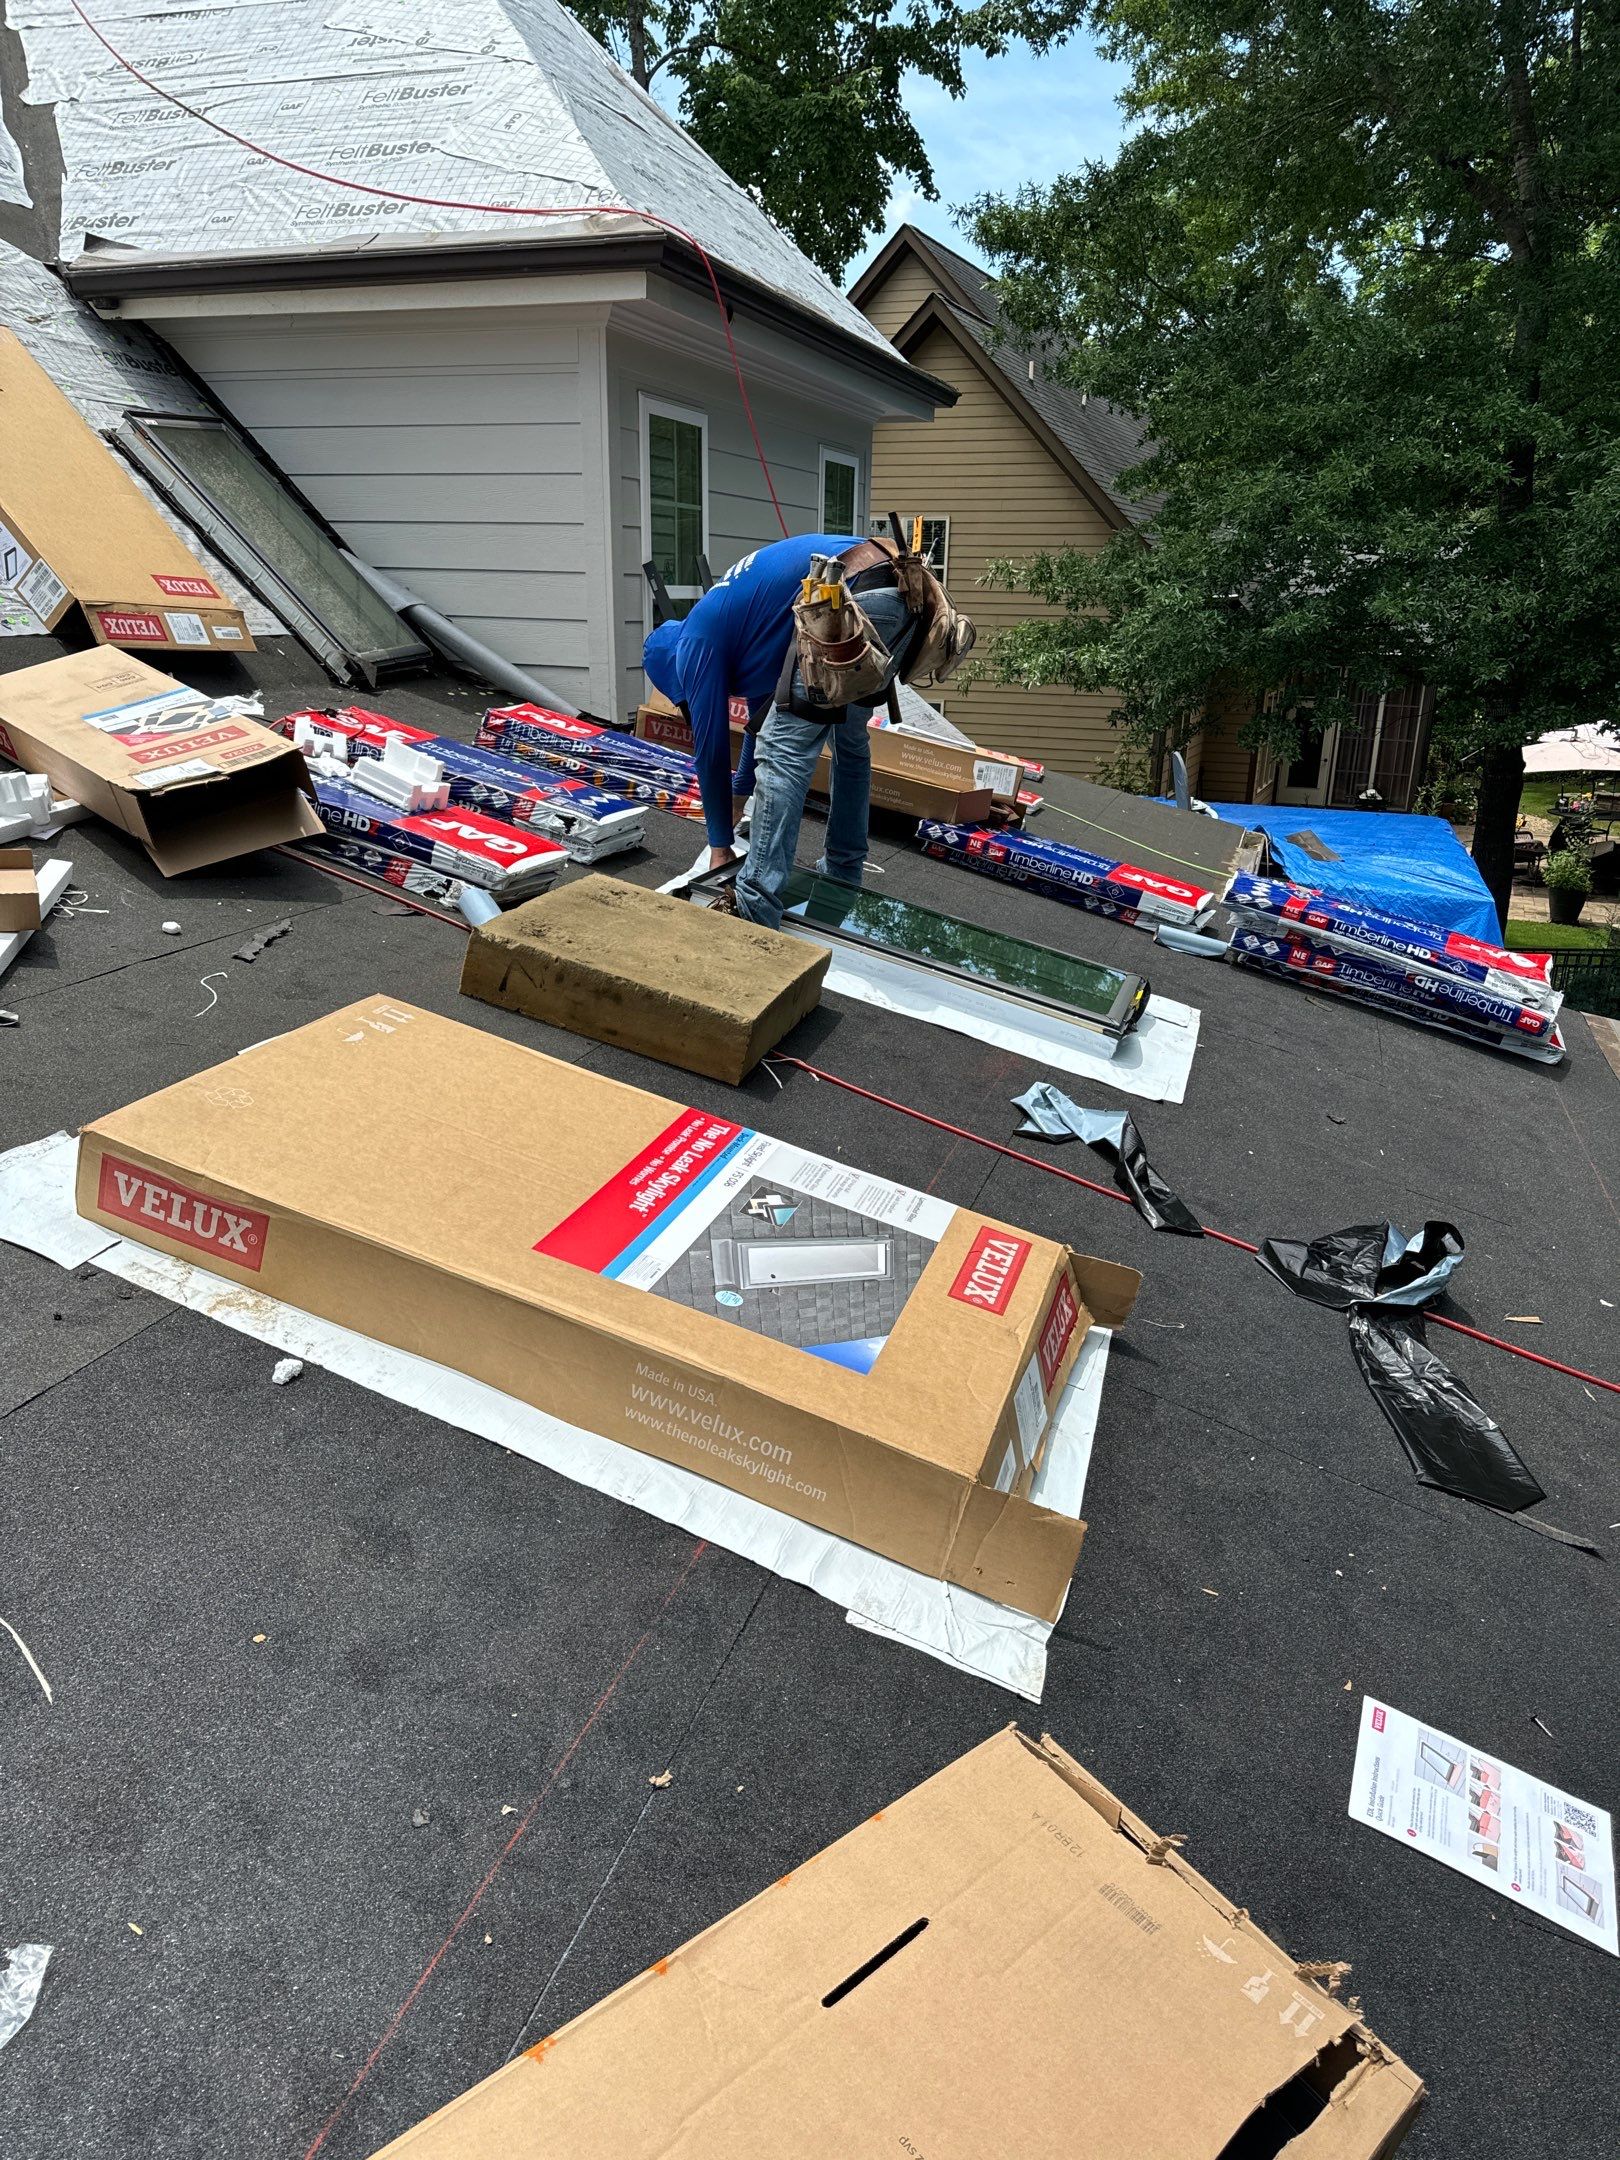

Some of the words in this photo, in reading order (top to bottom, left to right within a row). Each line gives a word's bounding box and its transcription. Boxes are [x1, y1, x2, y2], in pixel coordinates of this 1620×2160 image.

[361, 83, 473, 104] FeltBuster
[280, 102, 304, 111] GAF
[504, 113, 522, 131] GAF
[75, 158, 177, 177] FeltBuster
[246, 157, 269, 166] GAF
[294, 200, 410, 220] FeltBuster
[211, 215, 235, 224] GAF
[651, 719, 694, 743] VELU
[140, 730, 238, 761] VELUX
[224, 744, 262, 759] VELUX
[901, 751, 962, 773] www.velux.com
[421, 817, 529, 854] GAF
[970, 839, 982, 848] NE
[1118, 871, 1193, 898] GAF
[1123, 909, 1139, 919] NE
[1286, 905, 1300, 915] NE
[1308, 914, 1327, 925] GAF
[1292, 949, 1307, 961] NE
[1314, 959, 1334, 969] GAF
[1519, 1016, 1541, 1028] GAF
[680, 1125, 696, 1137] Leak
[703, 1123, 731, 1139] The
[662, 1135, 687, 1155] Promise
[691, 1137, 716, 1152] No
[649, 1157, 664, 1167] No
[668, 1150, 703, 1173] Leak
[629, 1165, 657, 1186] Worries
[635, 1362, 670, 1386] Made
[673, 1379, 684, 1392] in
[630, 1383, 793, 1465] www.velux.com
[624, 1406, 828, 1502] www.thenoleakskylight.com
[898, 2136, 918, 2156] svp
